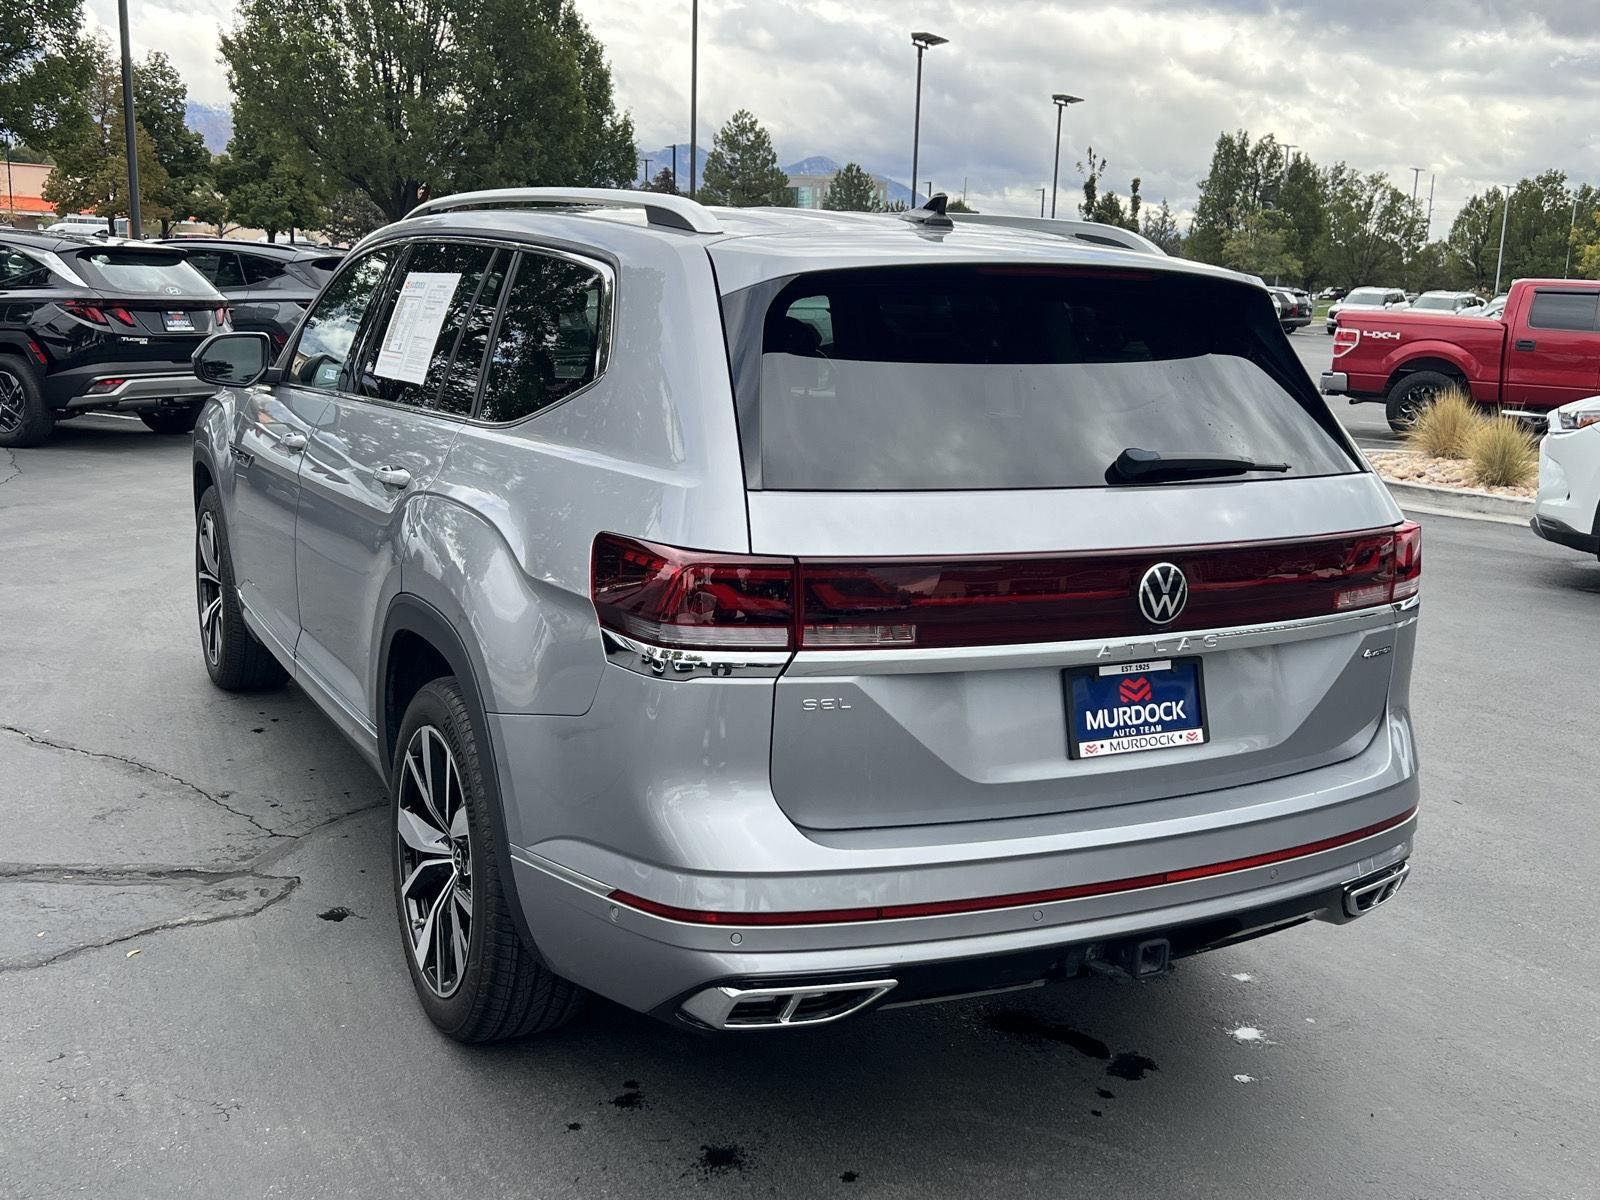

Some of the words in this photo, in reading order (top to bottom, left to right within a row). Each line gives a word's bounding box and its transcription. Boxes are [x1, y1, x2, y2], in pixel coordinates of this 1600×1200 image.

[1096, 633, 1218, 659] ATLAS
[1121, 665, 1134, 673] EST.
[1135, 663, 1150, 671] 1925
[802, 698, 852, 710] SEL
[1085, 700, 1187, 730] MURDOCK
[1112, 727, 1136, 738] AUTO
[1139, 724, 1162, 735] TEAM
[1109, 734, 1176, 752] MURDOCK
